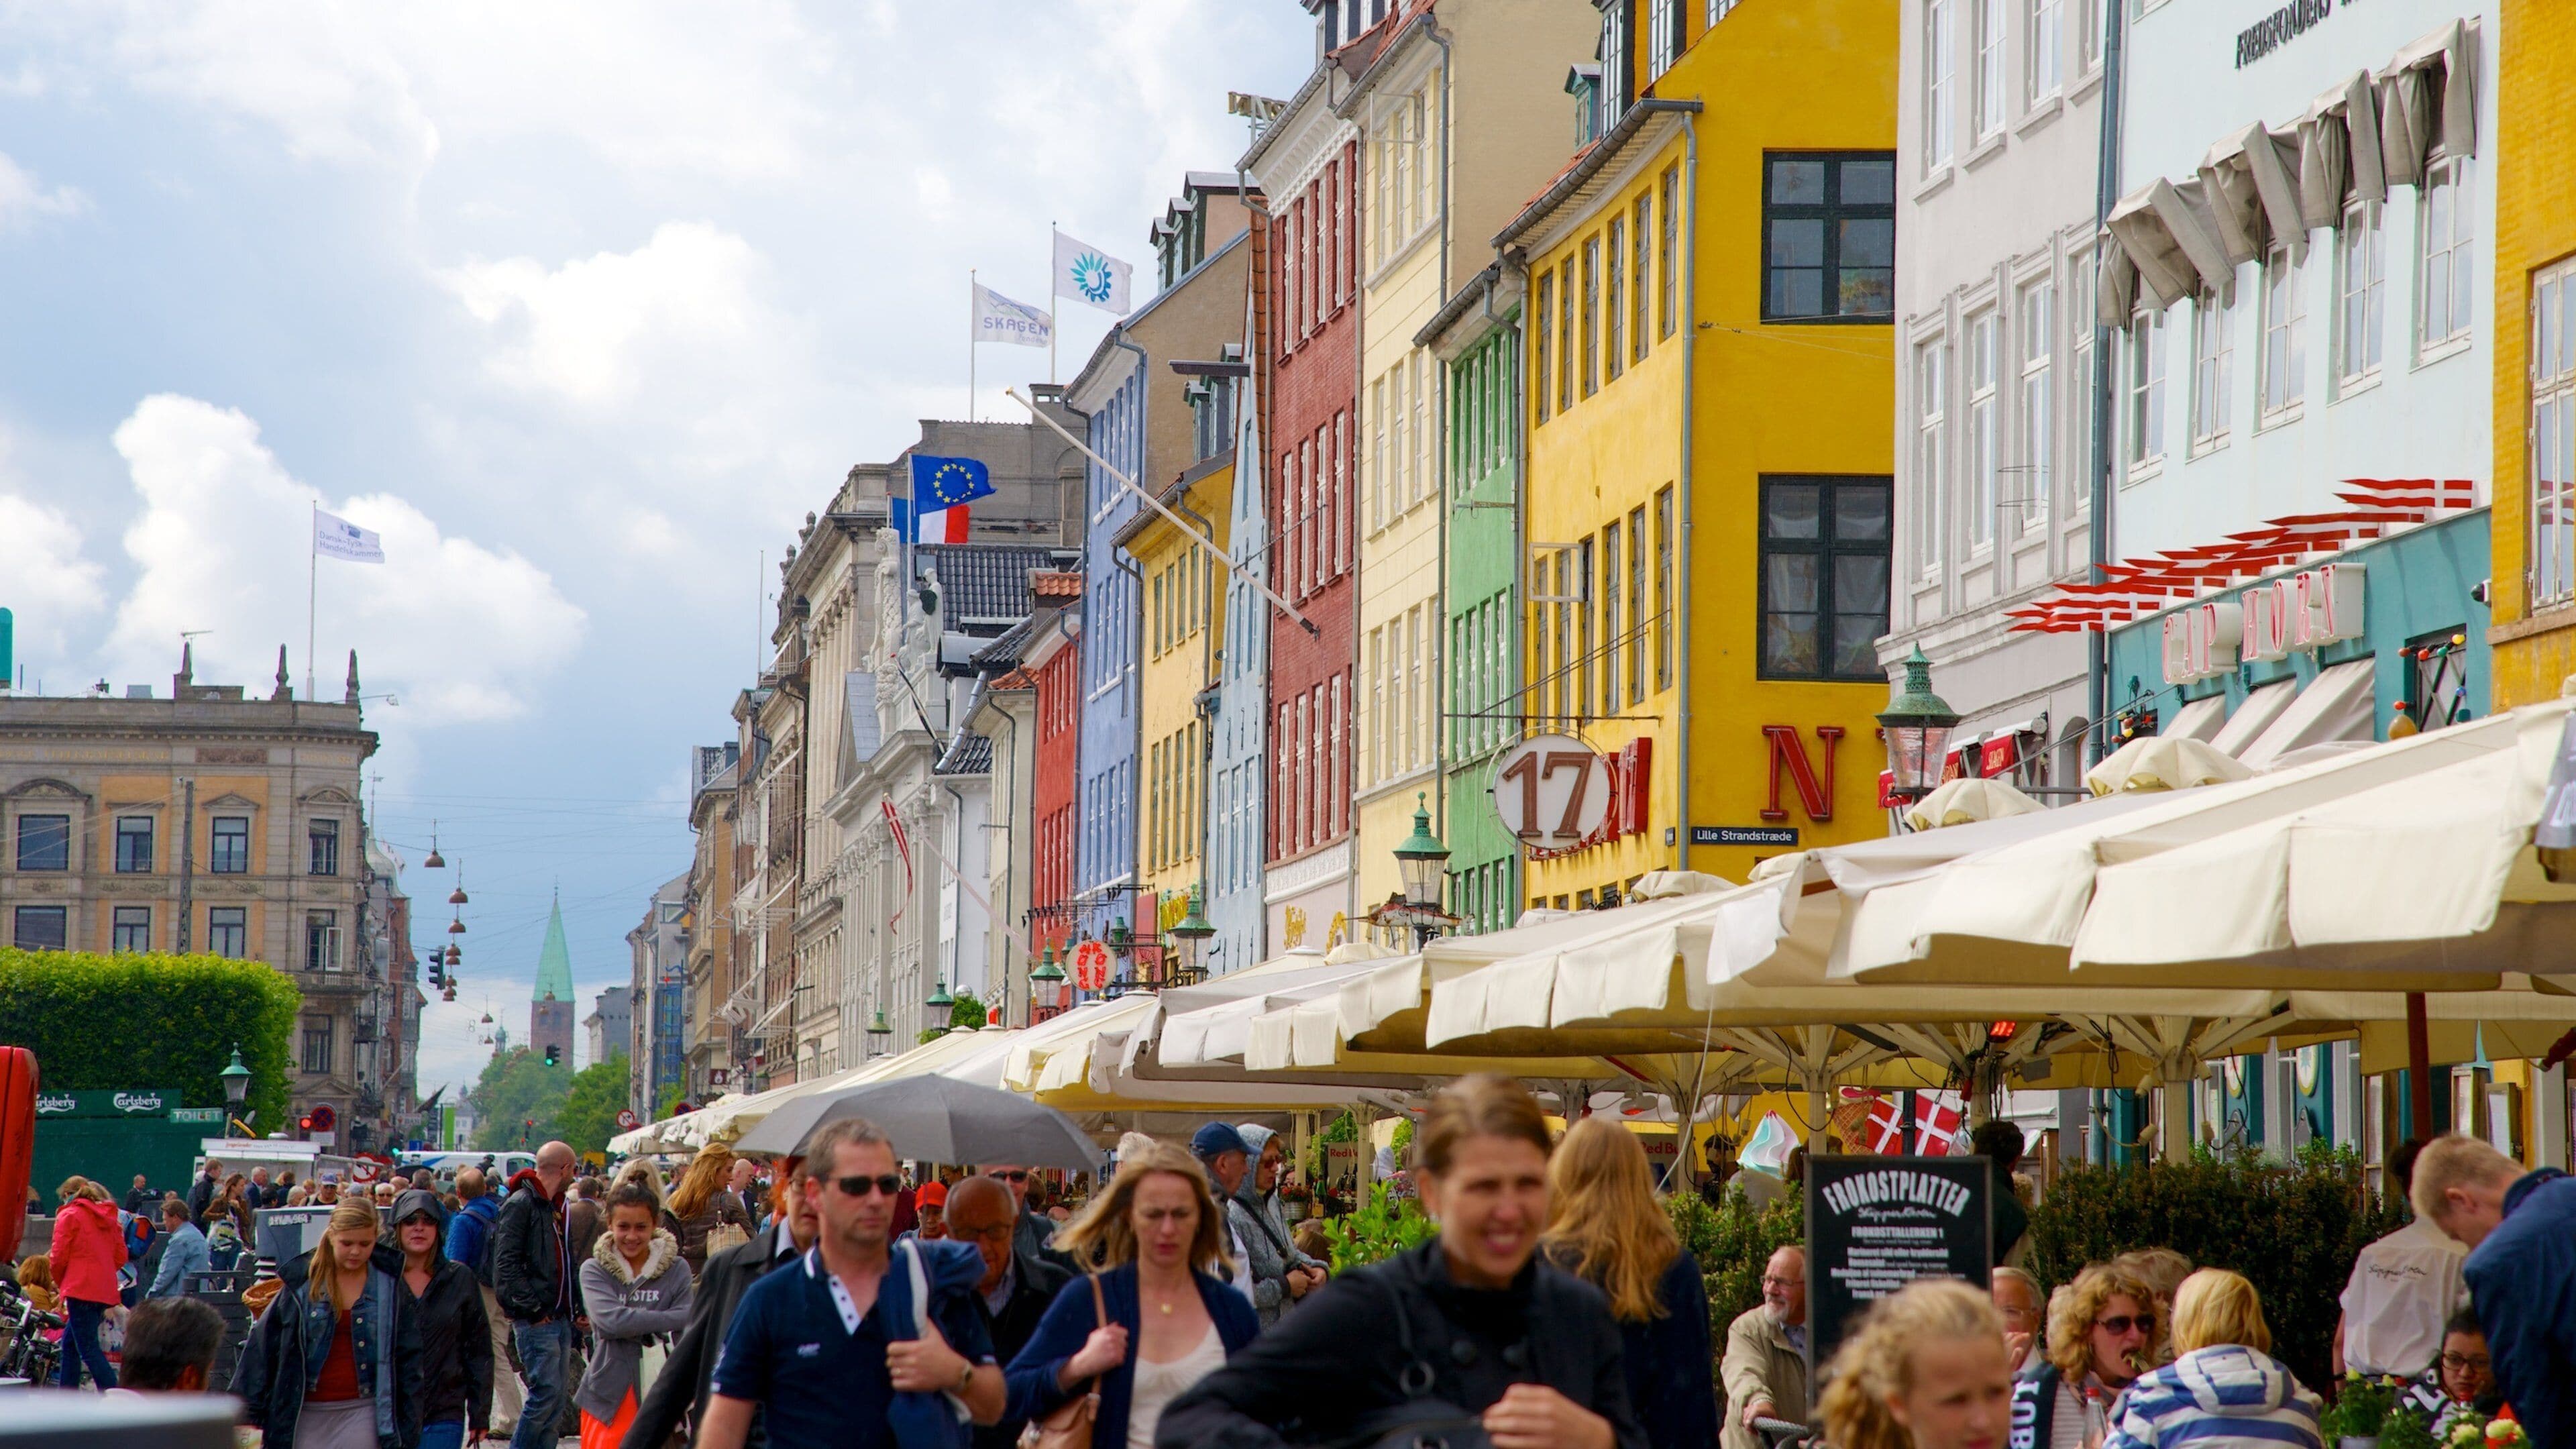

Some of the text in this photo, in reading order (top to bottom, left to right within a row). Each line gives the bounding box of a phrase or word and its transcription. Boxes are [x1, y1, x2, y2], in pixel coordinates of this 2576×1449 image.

[983, 317, 1049, 336] SKAGEN
[319, 531, 362, 547] Dansk-Tysk
[319, 540, 382, 557] Handelskammer
[1501, 751, 1594, 838] 17
[1697, 830, 1792, 842] Lille Strandstræde
[113, 1093, 161, 1111] Carlsberg
[173, 1110, 221, 1122] TOILET
[1330, 1148, 1348, 1157] Red
[1642, 1141, 1663, 1154] ed
[1822, 1170, 1971, 1218] FROKOSTPLATTER
[1851, 1226, 1944, 1239] FROKOSTTALLERKEN 1
